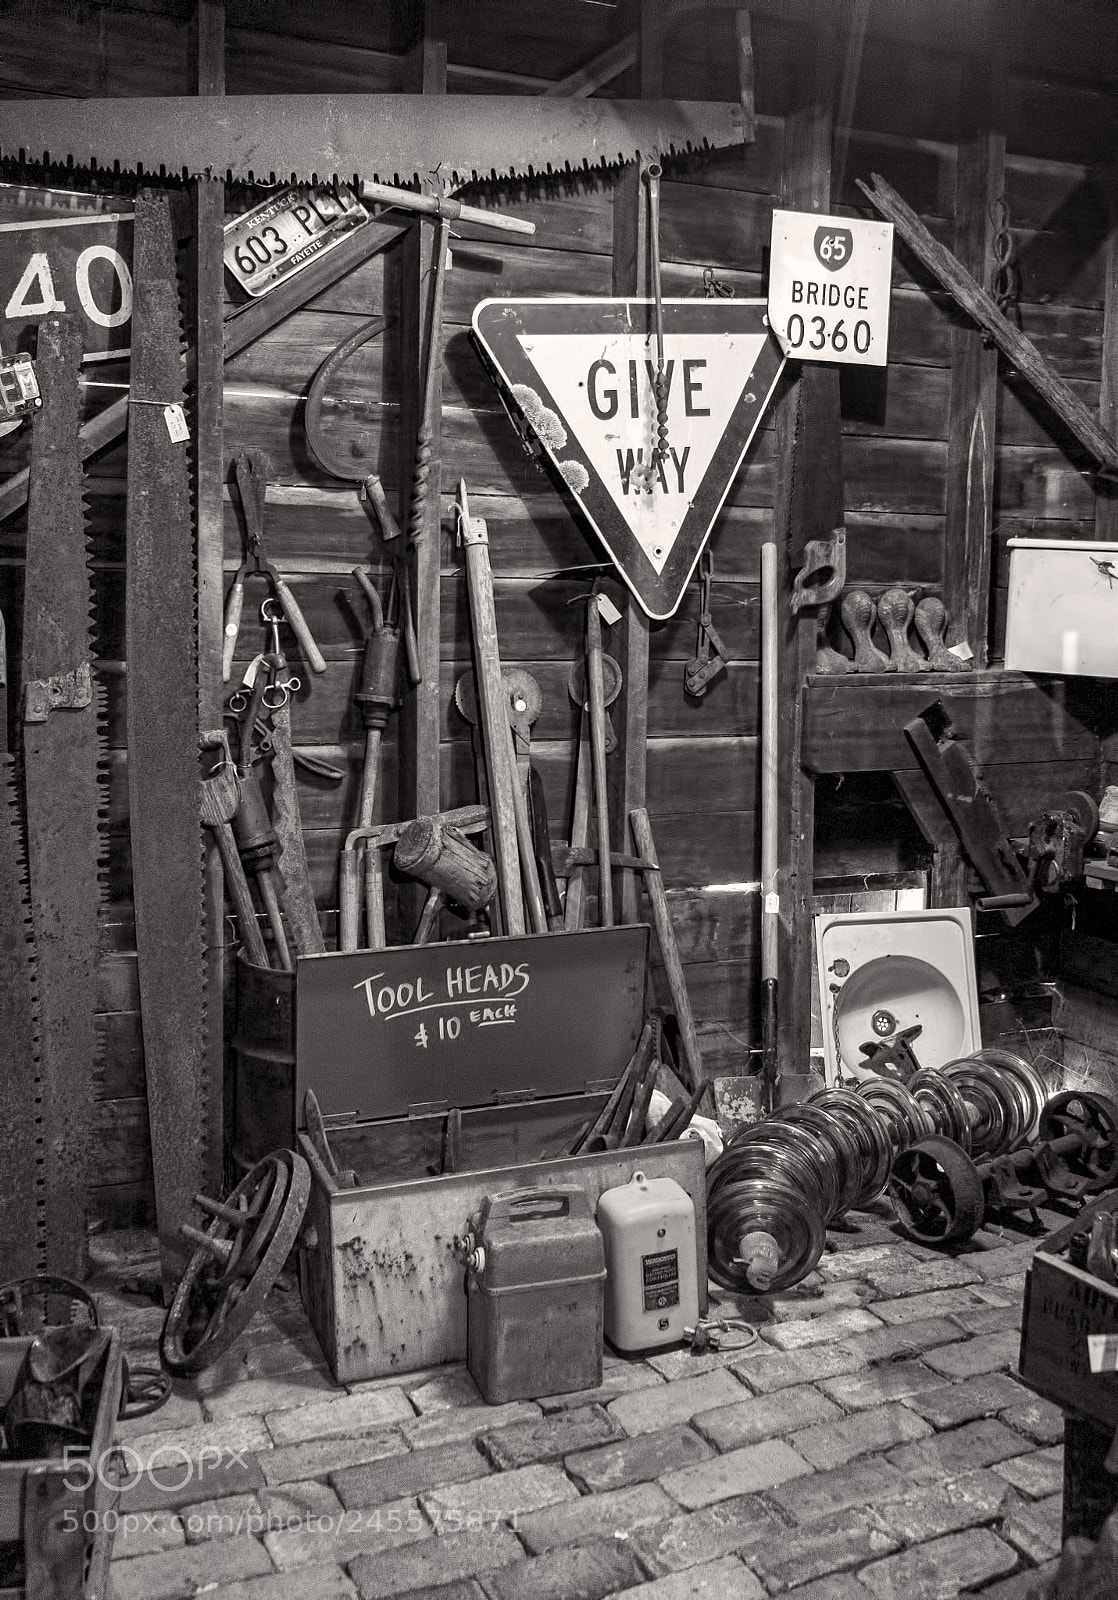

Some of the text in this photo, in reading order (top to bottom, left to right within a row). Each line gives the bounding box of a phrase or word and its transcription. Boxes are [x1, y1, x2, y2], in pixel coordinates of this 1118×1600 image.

[234, 226, 288, 274] 603
[290, 239, 323, 265] FAYETTE
[820, 235, 846, 260] 65
[5, 245, 133, 328] 40
[791, 280, 869, 310] BRIDGE
[786, 313, 871, 354] 0360
[587, 358, 711, 421] GIVE
[616, 446, 691, 495] WAY
[353, 962, 531, 1016] TOOL HEADS
[469, 1004, 517, 1023] EACH
